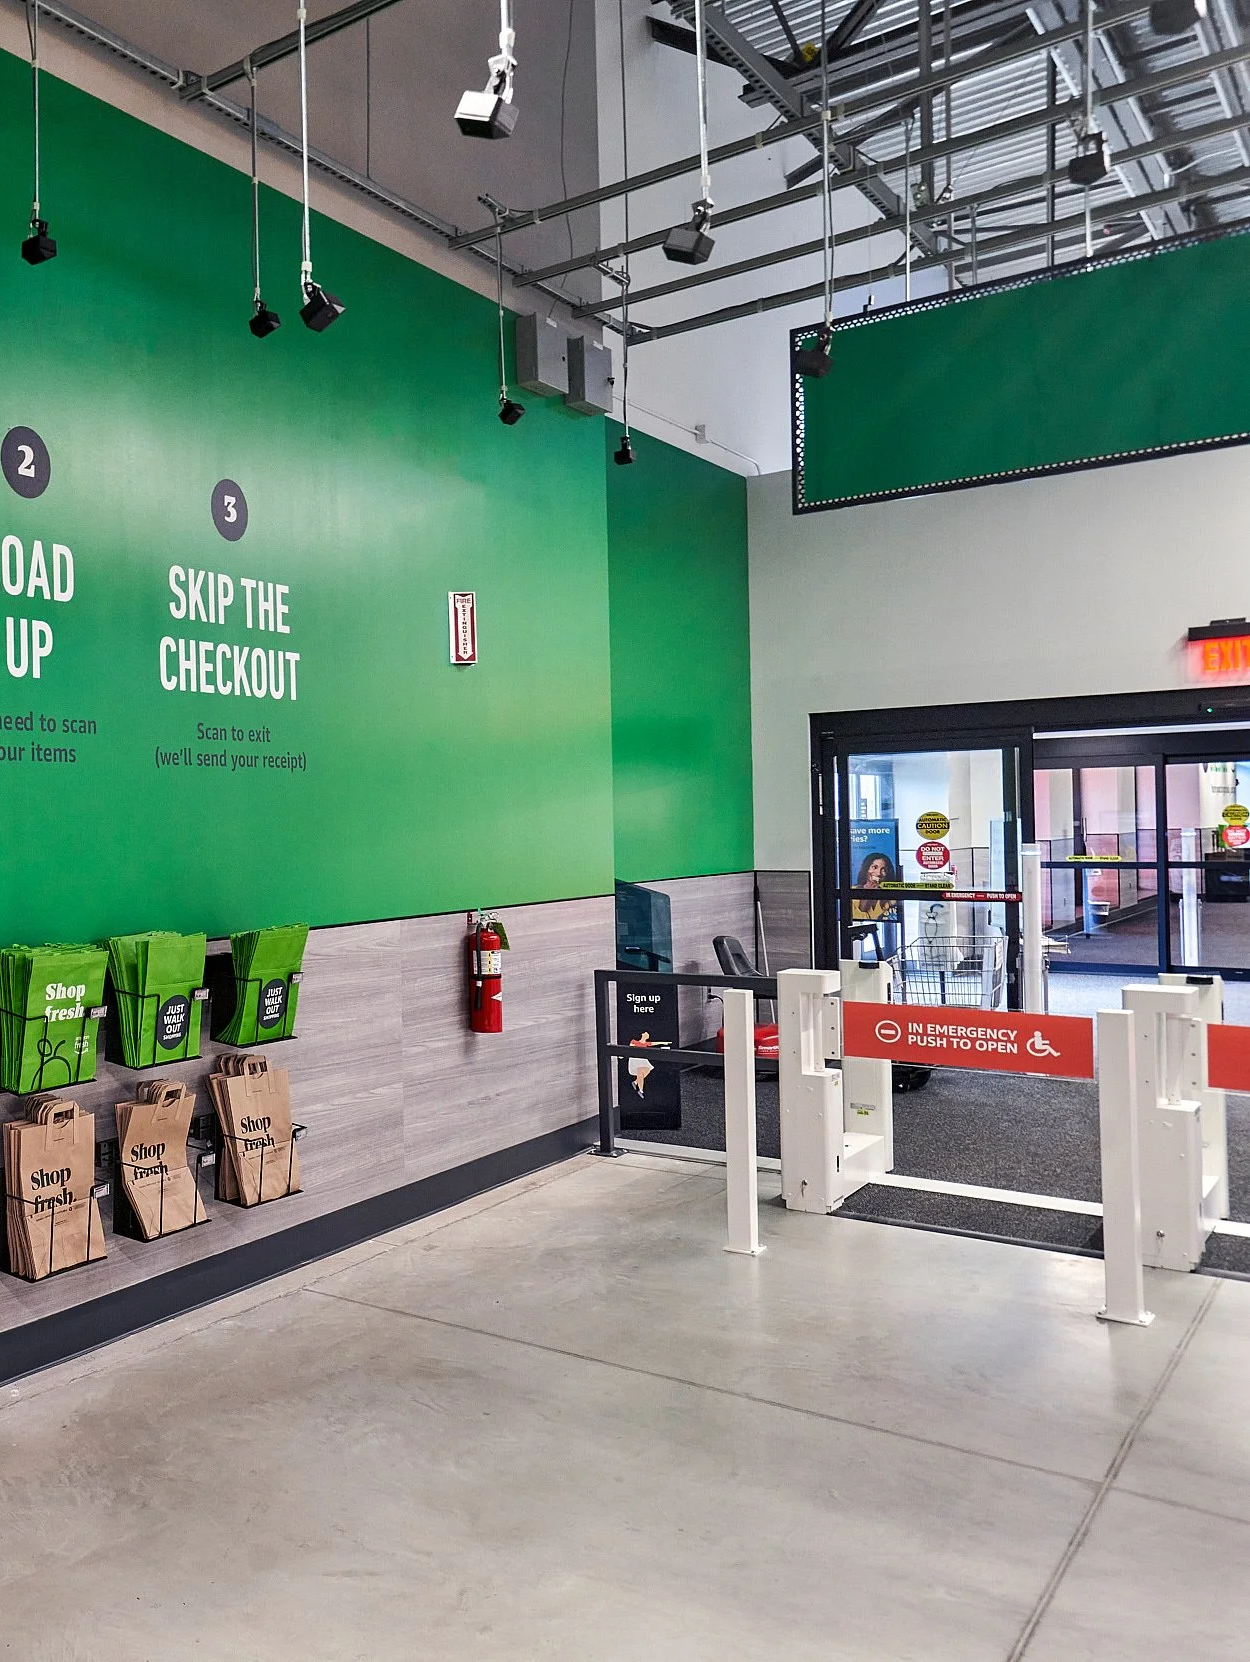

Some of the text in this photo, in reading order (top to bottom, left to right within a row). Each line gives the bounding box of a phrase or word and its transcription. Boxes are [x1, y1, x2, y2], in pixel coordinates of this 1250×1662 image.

[17, 444, 36, 478] 2
[223, 494, 238, 523] 3
[168, 561, 291, 635] SKIP THE
[5, 616, 53, 679] UP
[159, 635, 301, 701] CHECKOUT
[39, 714, 57, 733] to
[62, 718, 98, 735] scan
[196, 722, 271, 743] Scan to exit
[30, 743, 77, 763] items
[154, 746, 307, 773] (we'll send your receipt)
[45, 982, 86, 1002] Shop
[264, 995, 283, 1007] WALK
[266, 986, 284, 998] JUST
[626, 993, 661, 1004] Sign up
[166, 1003, 185, 1015] JUST
[265, 1004, 280, 1015] OUT
[633, 1004, 655, 1013] here
[163, 1013, 186, 1025] WALK
[165, 1023, 182, 1034] OUT
[908, 1022, 1018, 1041] IN EMERGENCY
[908, 1034, 1018, 1054] PUSH TO OPEN
[240, 1115, 271, 1135] Shop
[130, 1142, 166, 1163] Shop
[30, 1166, 72, 1191] Shop
